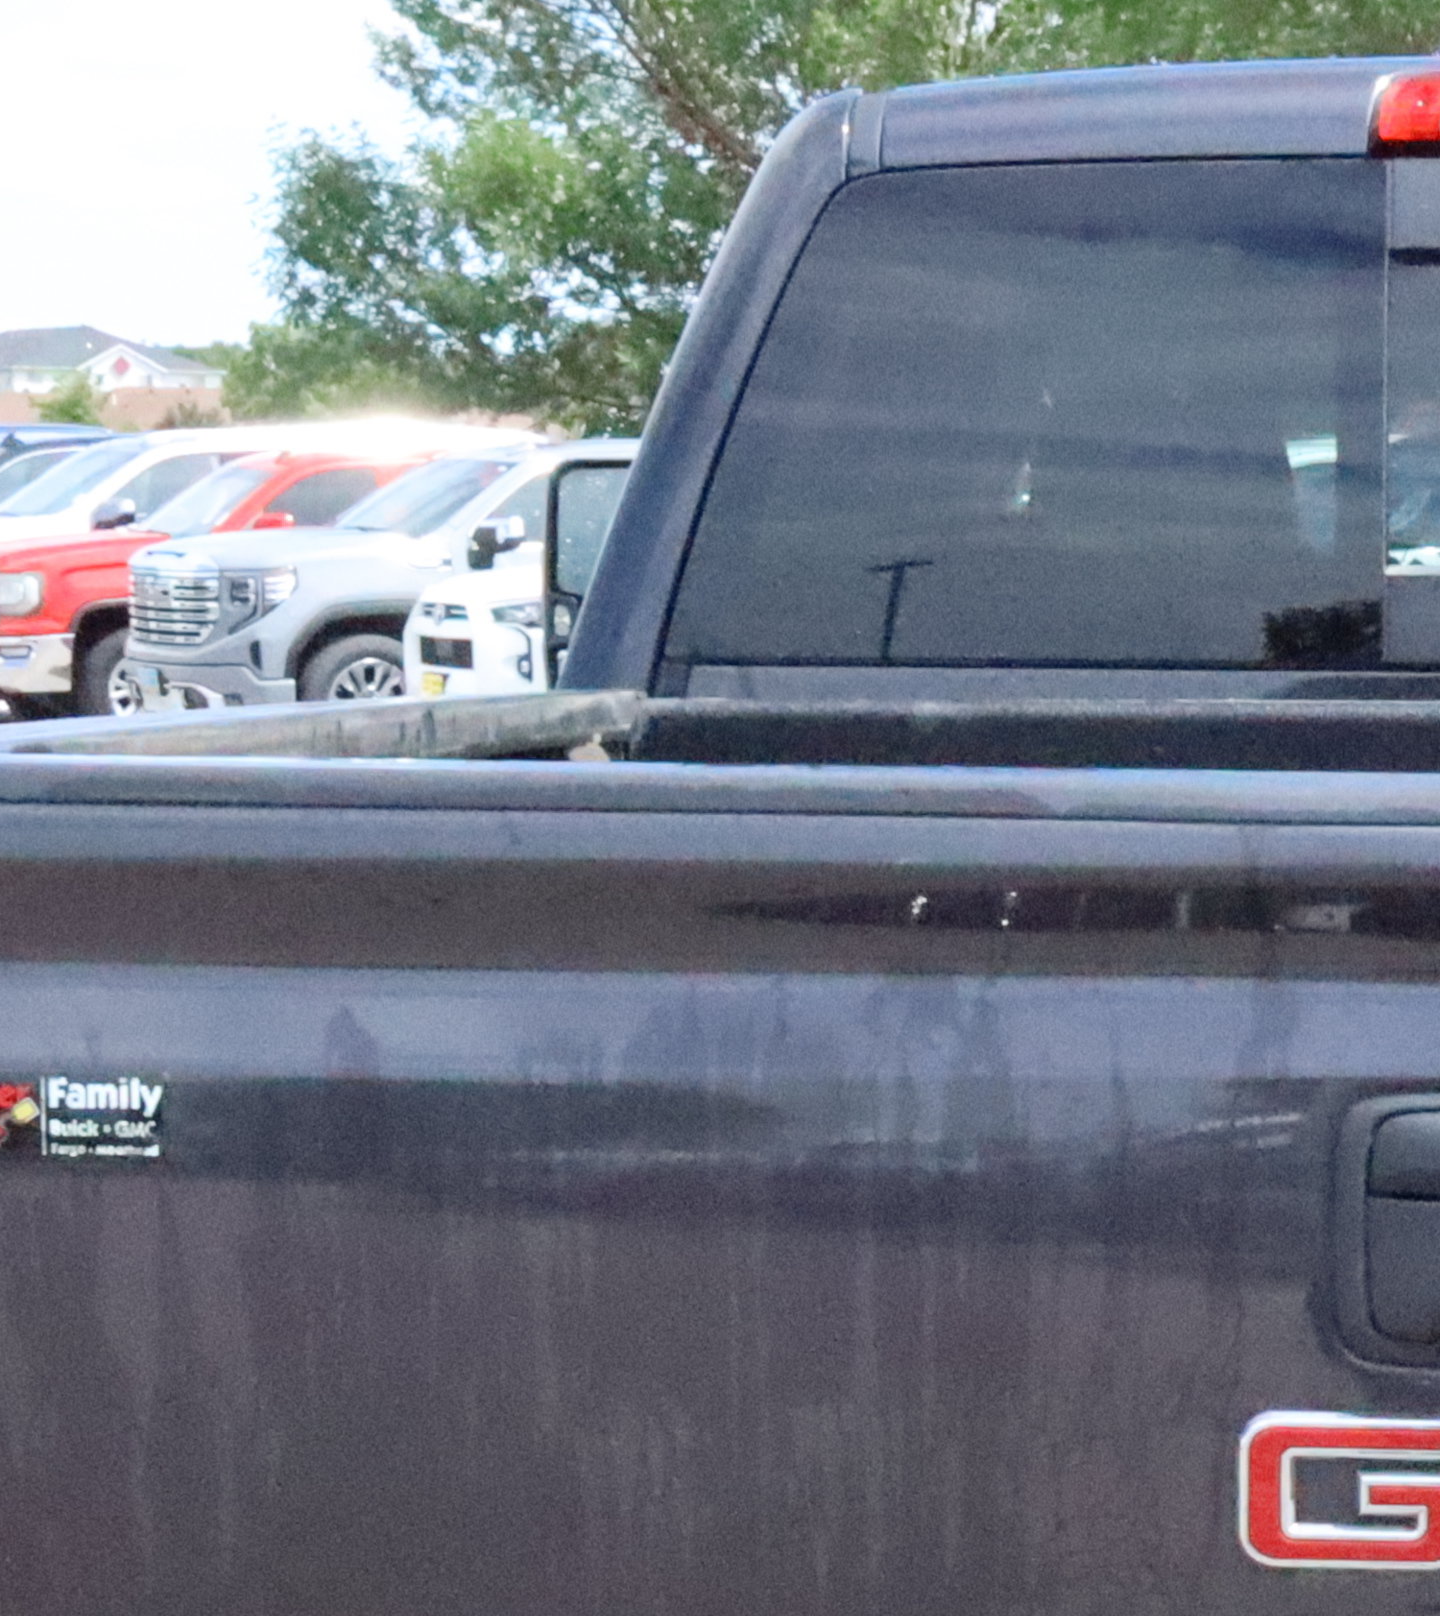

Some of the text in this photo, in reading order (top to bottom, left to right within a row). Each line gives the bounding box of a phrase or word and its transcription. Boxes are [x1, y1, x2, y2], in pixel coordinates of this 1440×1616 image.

[48, 1077, 162, 1118] Family
[49, 1118, 157, 1138] Buick GMC
